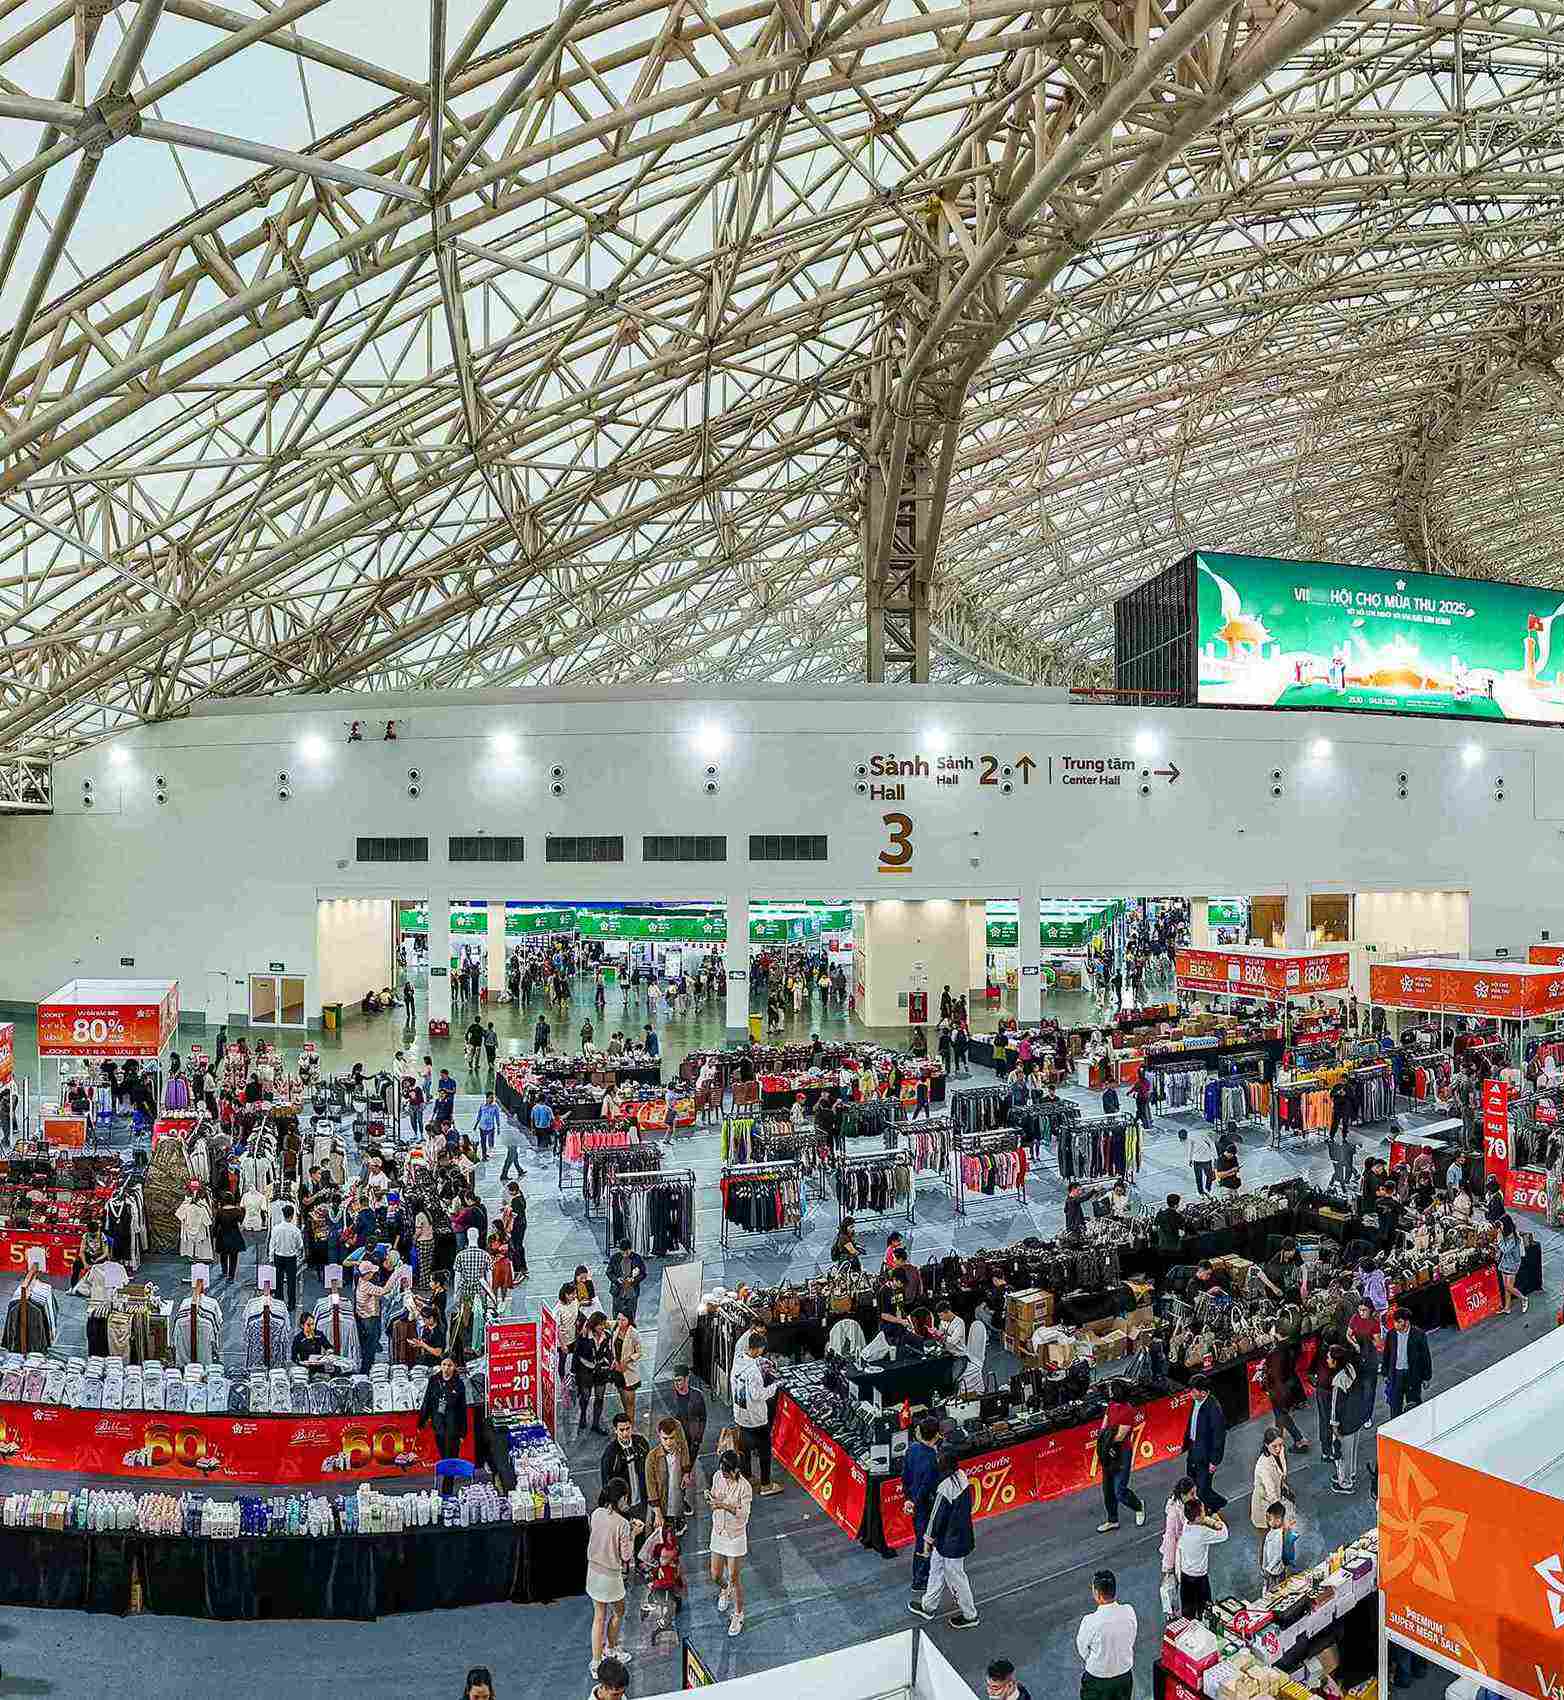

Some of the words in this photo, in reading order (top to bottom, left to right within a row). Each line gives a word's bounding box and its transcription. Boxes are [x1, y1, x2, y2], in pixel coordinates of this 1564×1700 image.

[1330, 589, 1352, 605] HỘI
[1355, 591, 1382, 609] CHỢ
[1384, 592, 1411, 610] MÙA
[1414, 597, 1437, 611] THU
[1439, 600, 1466, 615] 2025
[870, 754, 929, 777] Sảnh
[937, 755, 974, 770] Sảnh
[979, 755, 999, 785] 2
[1063, 756, 1105, 773] Trung
[1107, 756, 1136, 770] tâm
[870, 783, 905, 800] Hall
[937, 775, 959, 785] Hall
[1062, 775, 1097, 785] Center
[1099, 775, 1121, 785] Hall
[878, 812, 914, 866] 3
[72, 1018, 124, 1043] 80%
[1404, 1605, 1444, 1634] PREMIUM
[1389, 1611, 1417, 1634] SUPER
[1440, 1635, 1463, 1656] SALE
